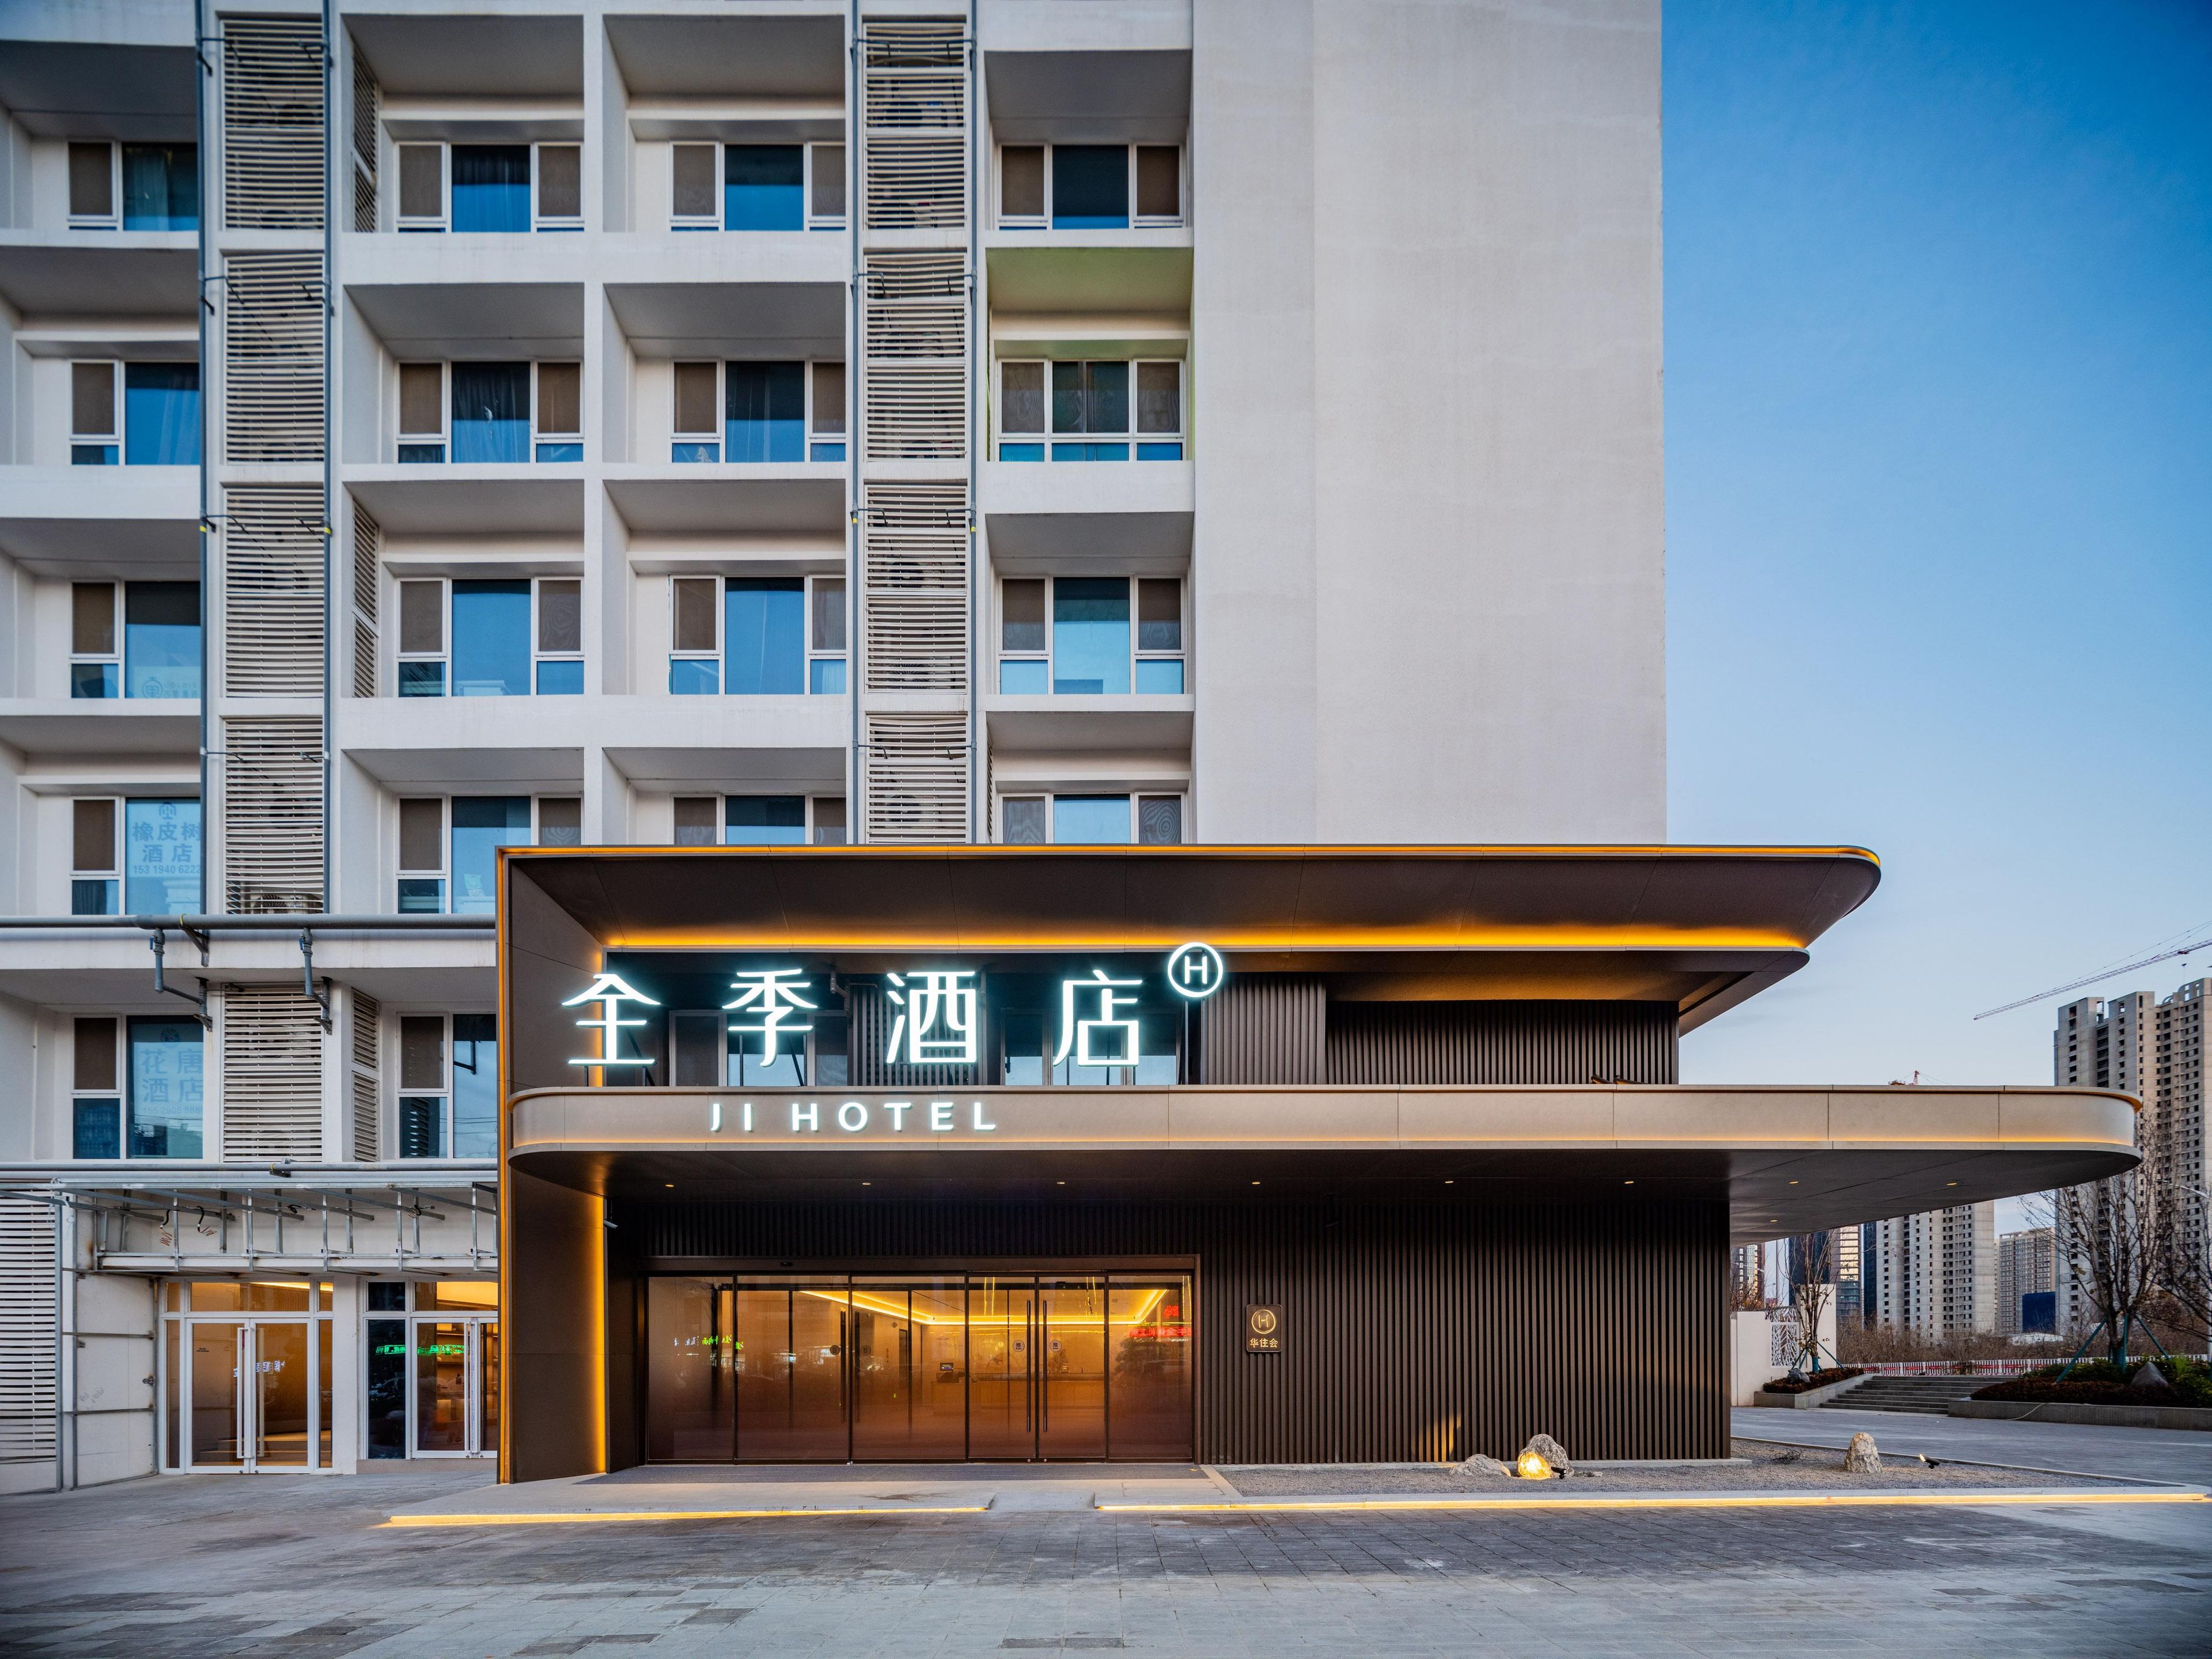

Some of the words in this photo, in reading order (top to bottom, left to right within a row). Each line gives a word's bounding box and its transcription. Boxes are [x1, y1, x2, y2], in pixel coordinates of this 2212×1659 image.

[132, 821, 201, 842] 橡皮树
[142, 844, 193, 863] 酒店
[134, 865, 150, 874] 153
[153, 865, 176, 874] 1940
[561, 968, 1143, 1067] 全季酒店
[141, 1048, 203, 1074] 花唐
[142, 1076, 203, 1103] 酒店
[710, 1103, 752, 1131] JI
[791, 1101, 997, 1132] HOTEL
[1249, 1338, 1278, 1348] 华住会
